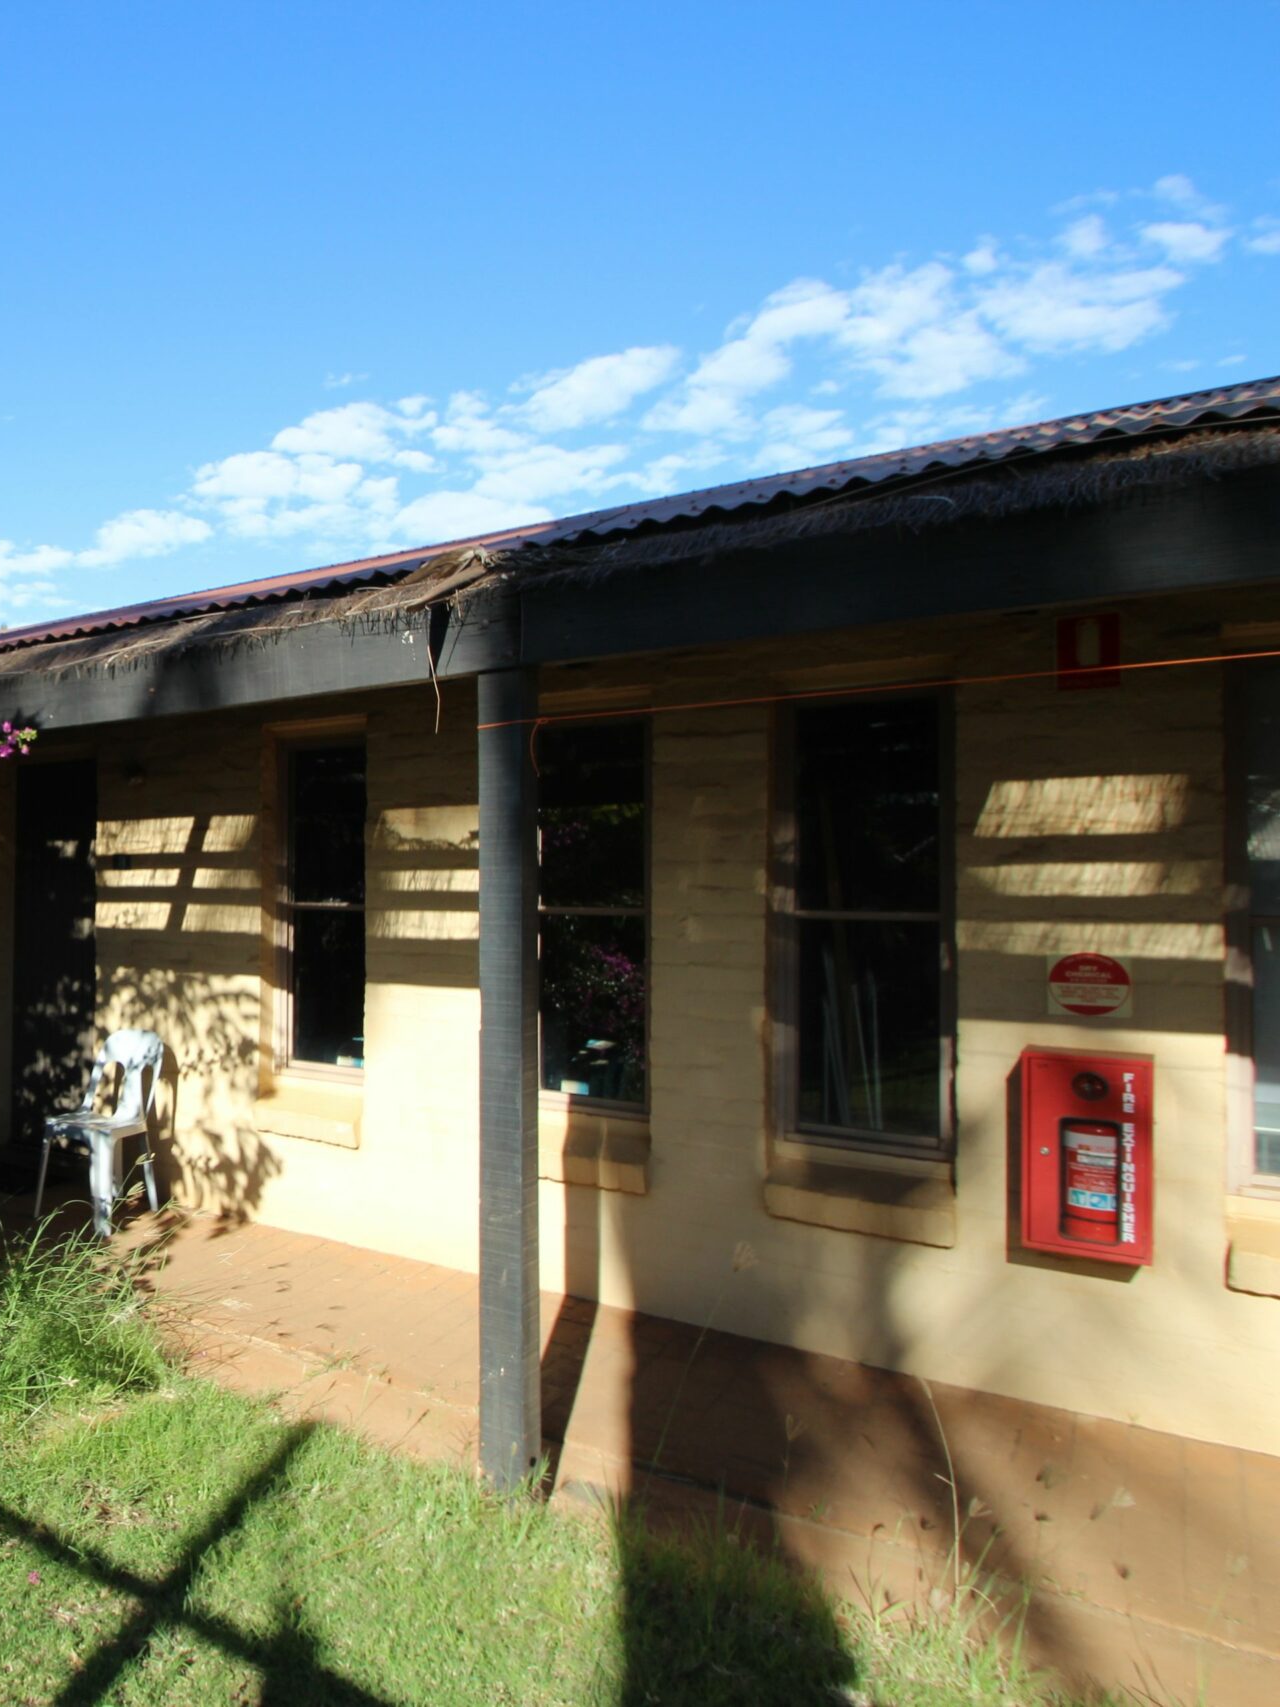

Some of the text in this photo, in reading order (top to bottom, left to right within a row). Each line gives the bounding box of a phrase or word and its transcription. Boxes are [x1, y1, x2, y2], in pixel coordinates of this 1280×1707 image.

[1065, 971, 1112, 979] CHEMICAL
[1121, 1072, 1135, 1243] FIRE EXTINGUISHER
